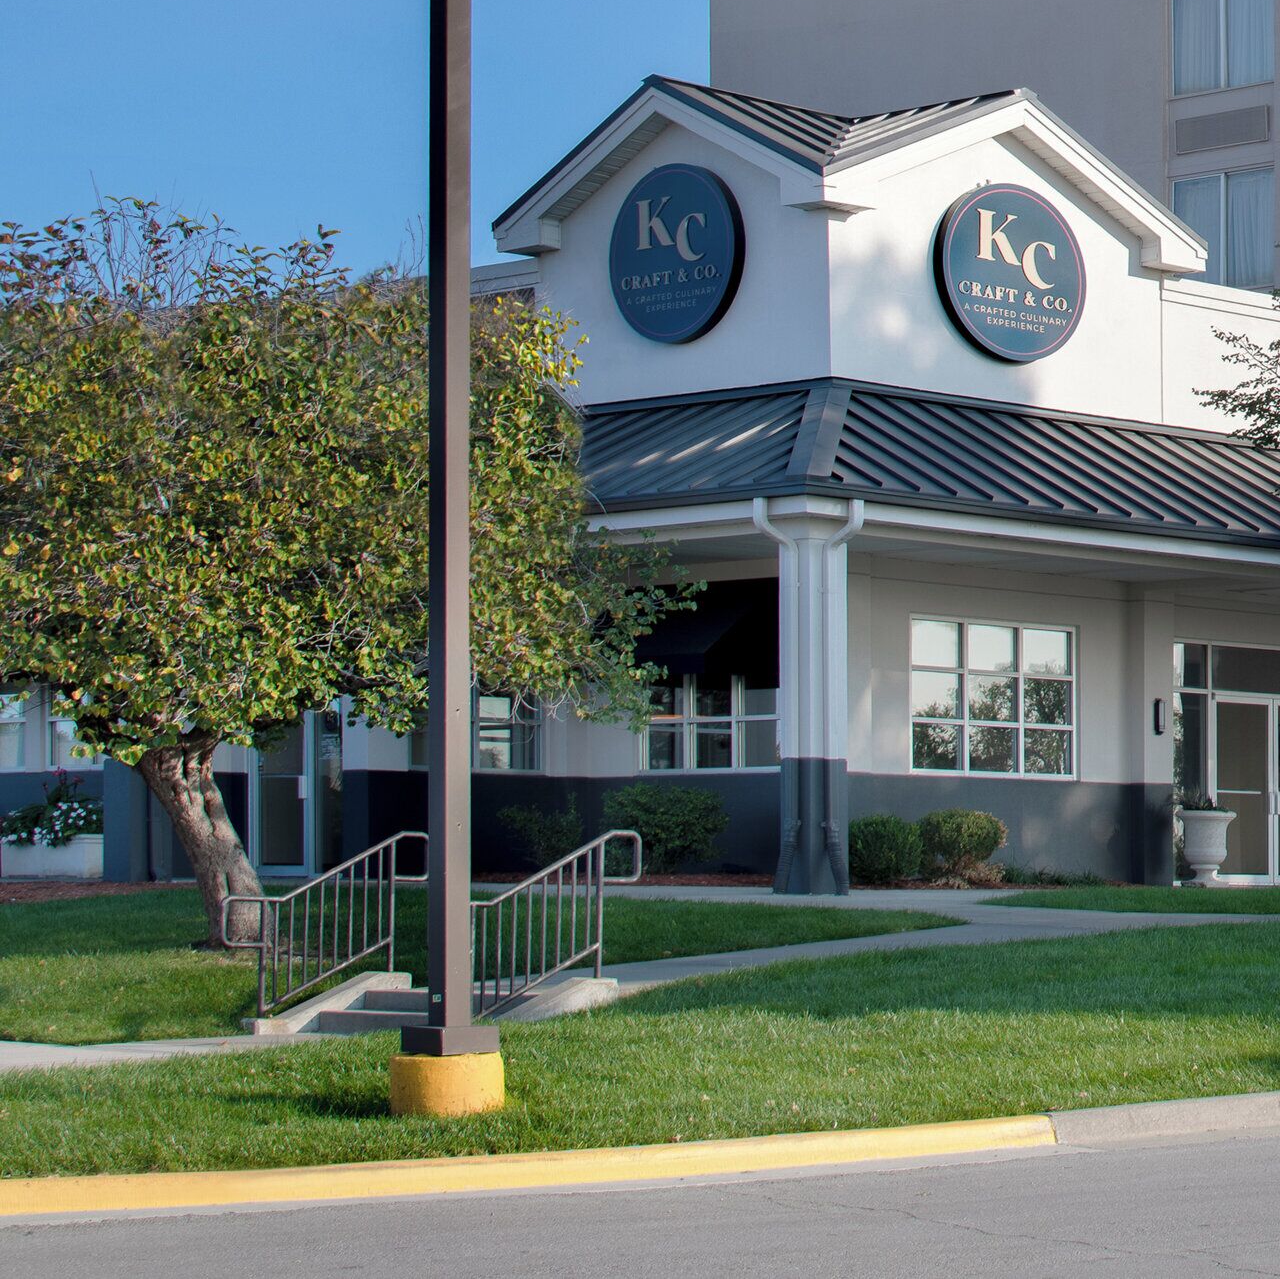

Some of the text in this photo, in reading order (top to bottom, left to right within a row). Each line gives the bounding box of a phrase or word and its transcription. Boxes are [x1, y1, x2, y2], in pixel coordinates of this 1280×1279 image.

[636, 196, 706, 261] KC
[976, 208, 1056, 290] KC
[621, 264, 720, 290] CRAFT & CO.
[626, 286, 716, 306] A CRAFTED CULINARY
[646, 299, 697, 313] EXPERIENCE
[959, 280, 1072, 313] CRAFT & CO.
[963, 302, 1067, 327] A CRAFTED CULINARY
[987, 316, 1045, 333] EXPERIENCE
